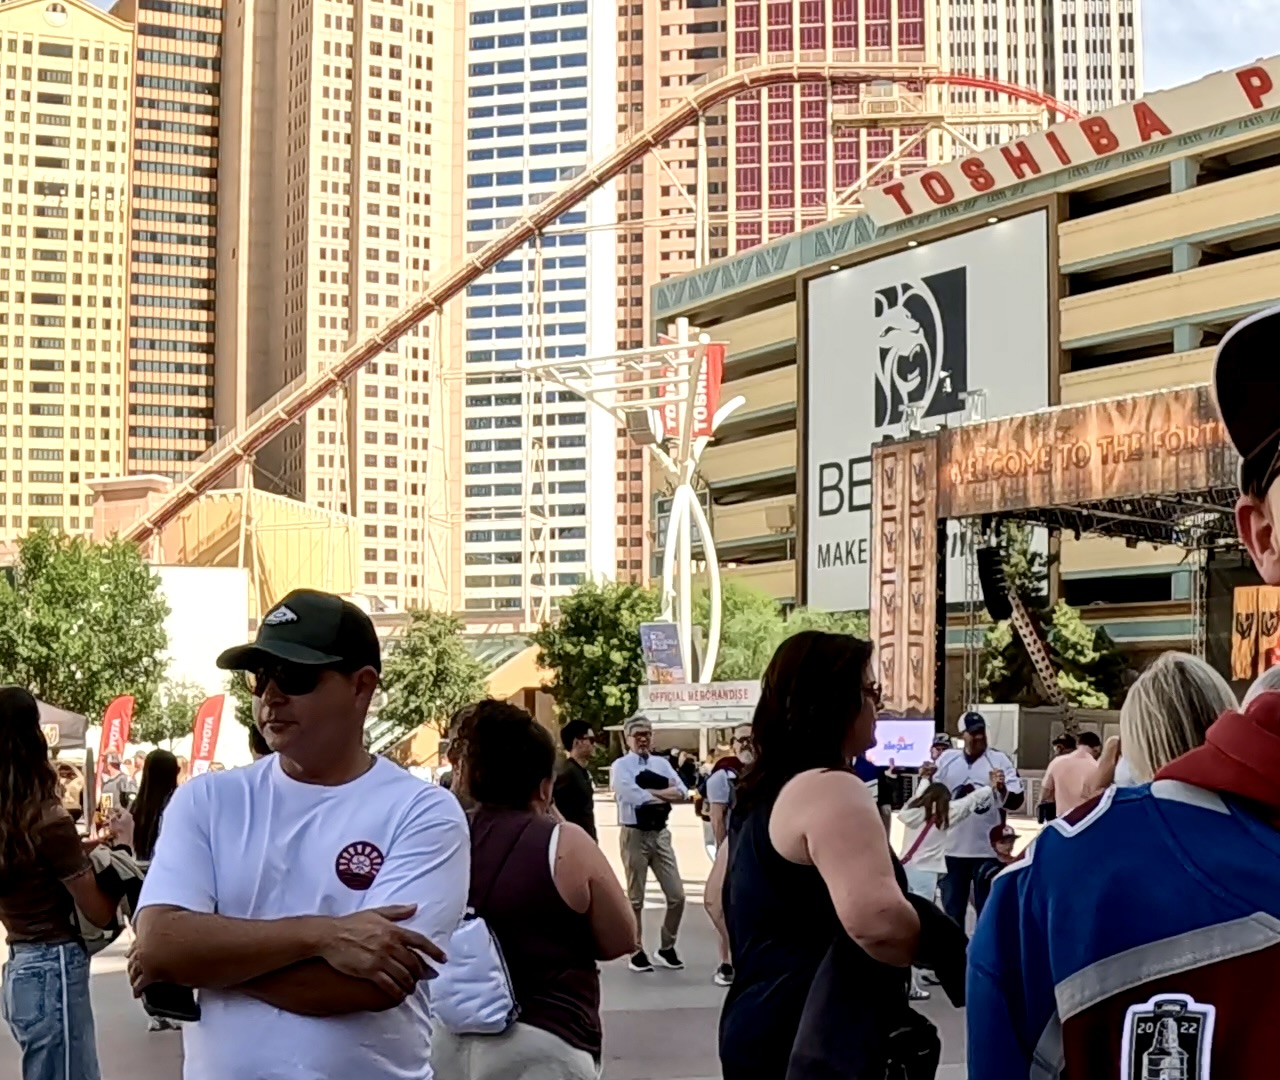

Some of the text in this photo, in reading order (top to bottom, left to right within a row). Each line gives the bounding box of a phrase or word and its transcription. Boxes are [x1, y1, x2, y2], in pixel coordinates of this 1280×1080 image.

[882, 102, 1173, 215] TOSHIBA
[950, 418, 1227, 485] WELCOME TO THE FORT
[817, 538, 868, 569] MAKE
[649, 689, 749, 703] OFFICIAL MERCHANDISE
[199, 716, 214, 757] TOYOTA
[1137, 1022, 1198, 1034] 20 22
